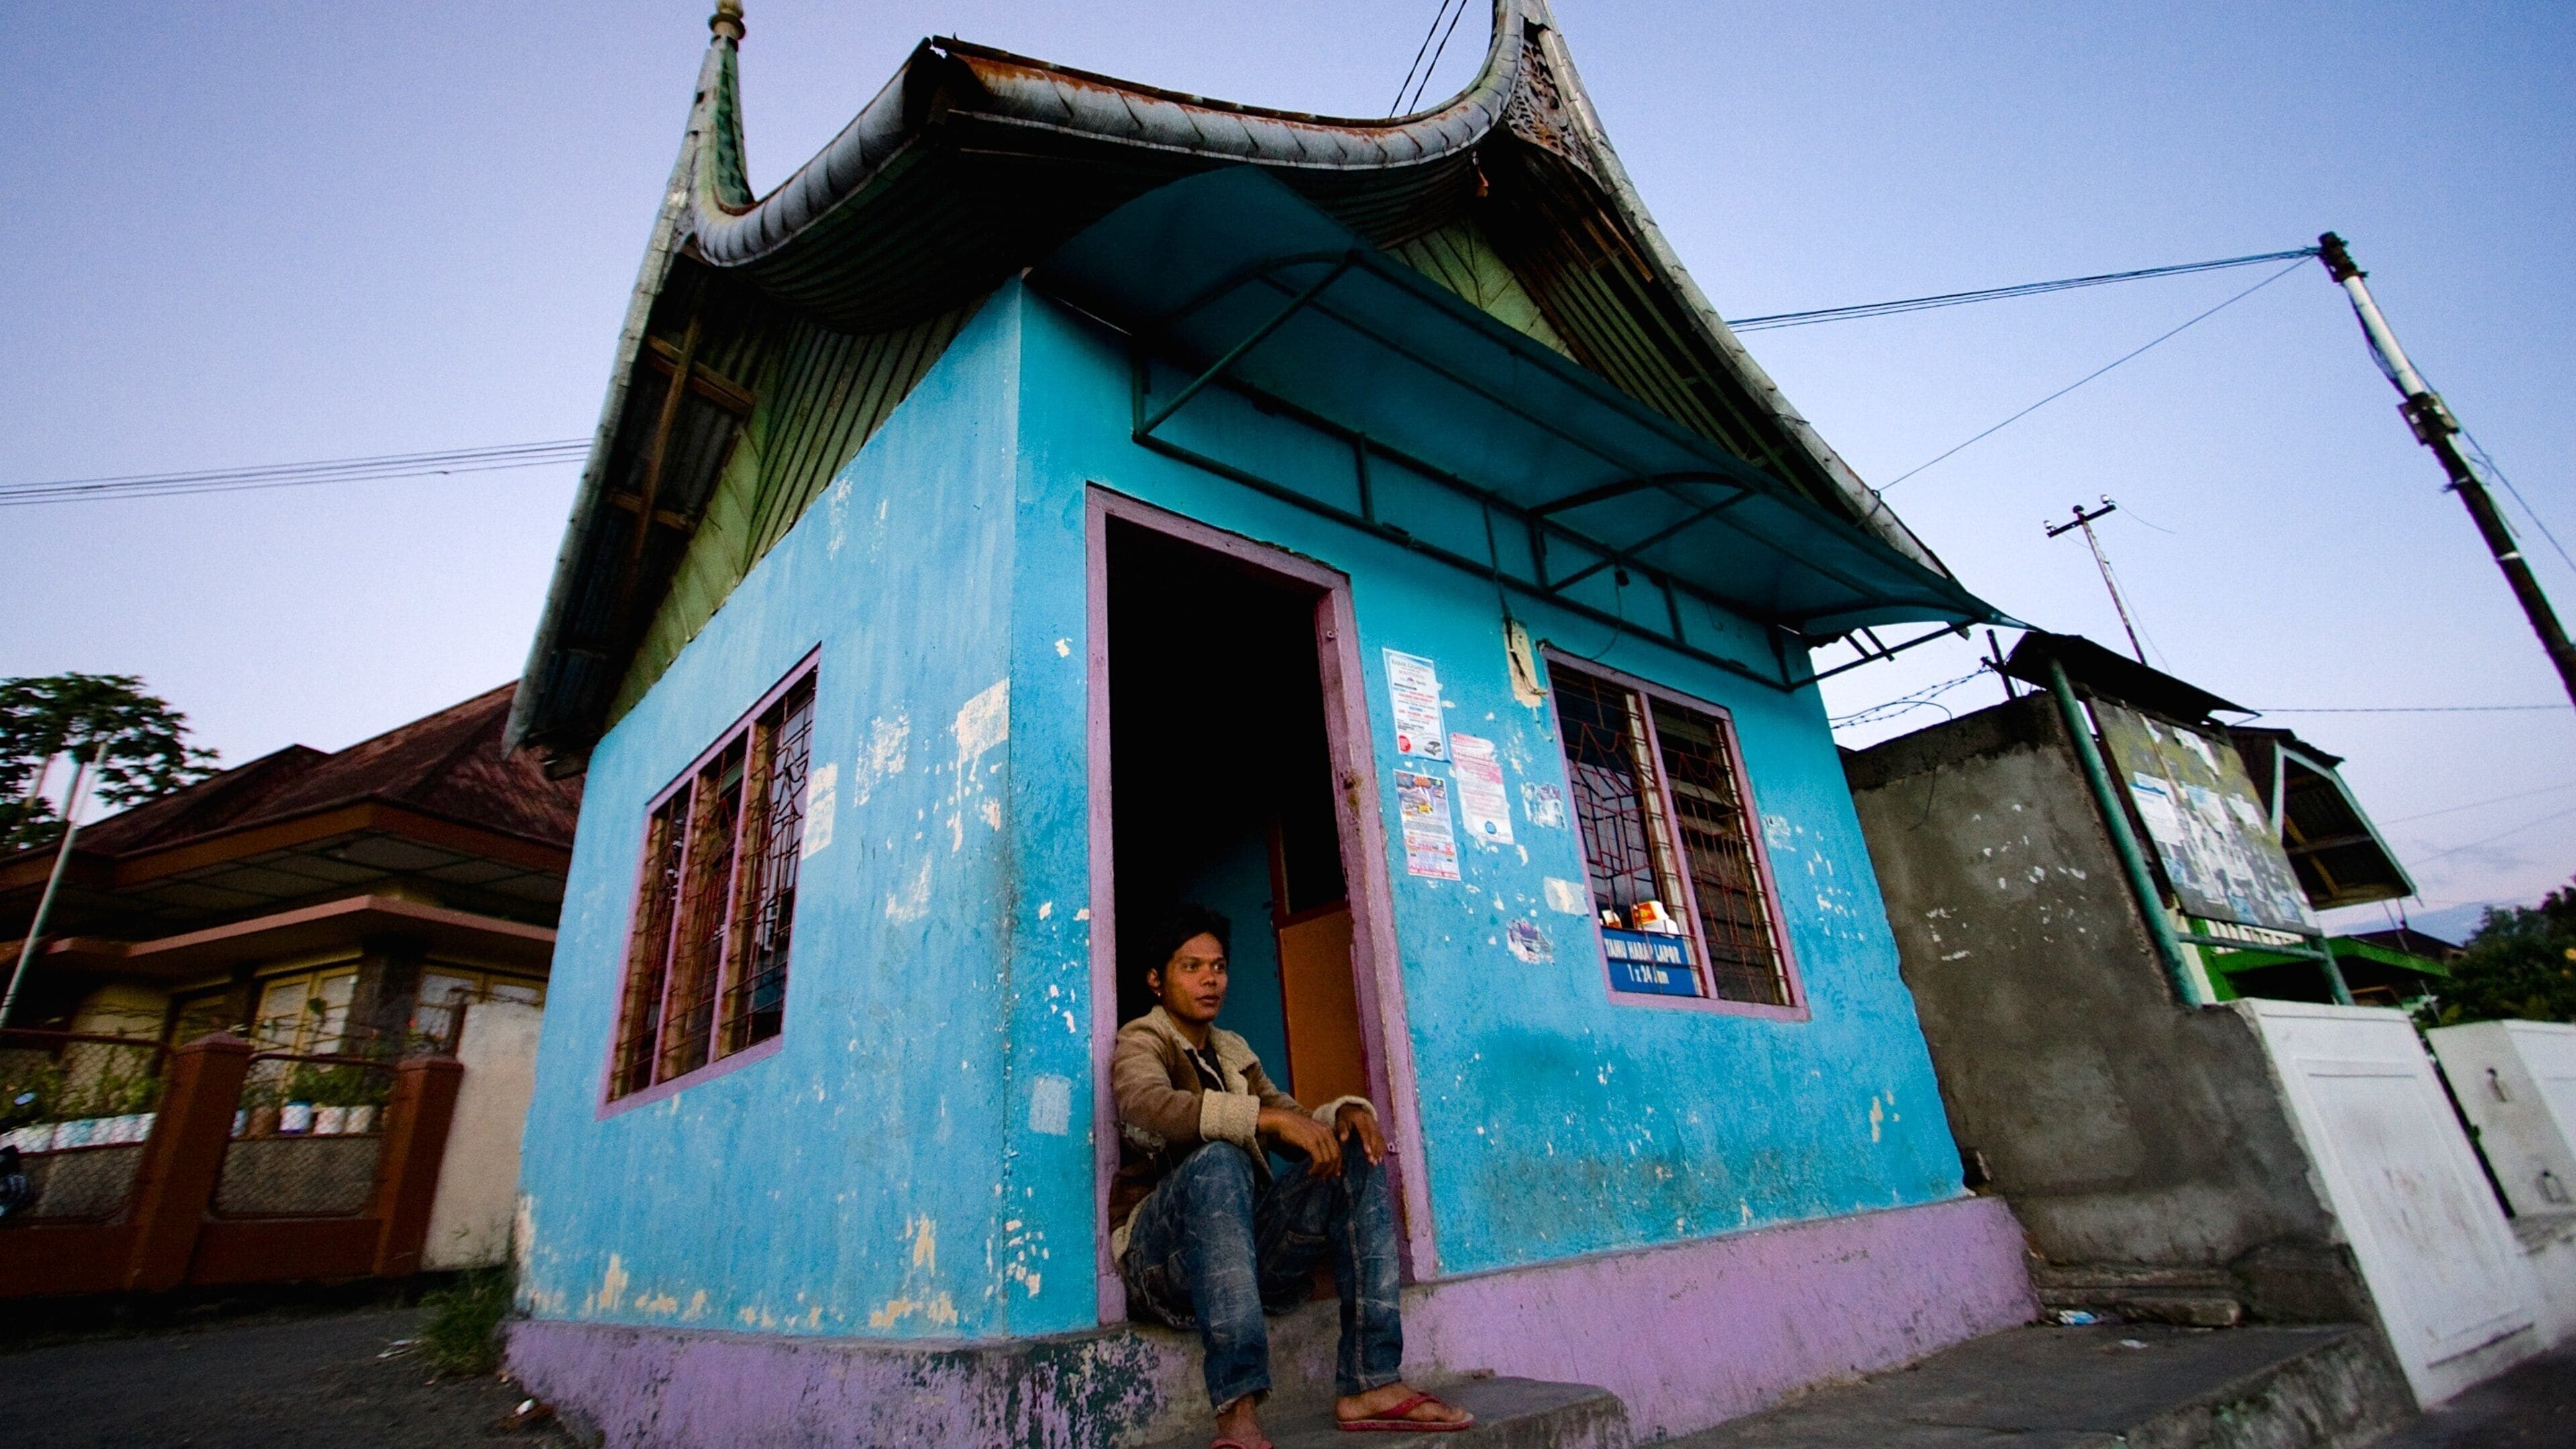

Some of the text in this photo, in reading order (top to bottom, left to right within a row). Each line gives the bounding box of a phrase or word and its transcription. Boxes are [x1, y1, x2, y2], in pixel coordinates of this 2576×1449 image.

[1604, 938, 1682, 964] TAMU HARAP LAPOR
[1627, 963, 1635, 982] 1
[1640, 965, 1653, 983] 24
